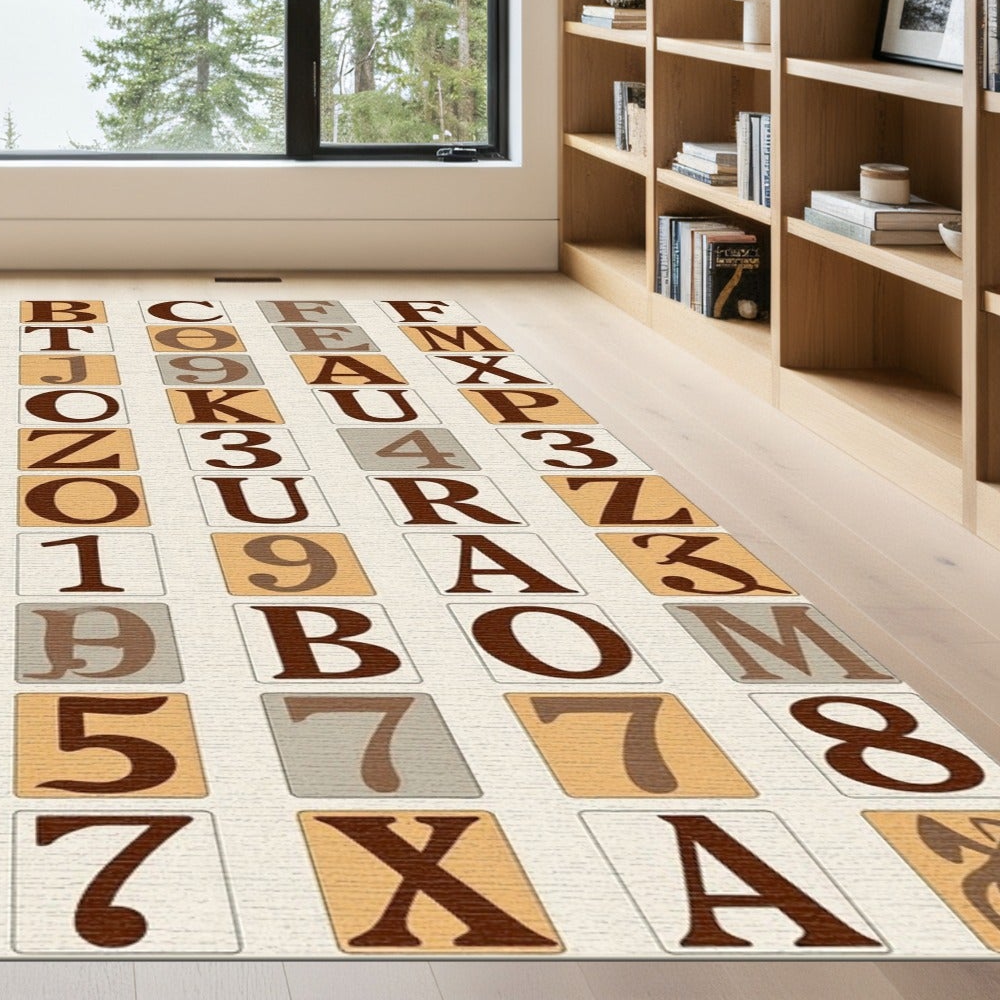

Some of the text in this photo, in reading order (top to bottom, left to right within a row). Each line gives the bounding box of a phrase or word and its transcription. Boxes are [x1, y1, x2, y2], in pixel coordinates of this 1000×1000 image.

[25, 301, 97, 322] B
[148, 301, 223, 322] C
[266, 301, 335, 322] F
[382, 301, 448, 322] F
[25, 326, 94, 351] T
[286, 327, 369, 351] E
[410, 326, 507, 351] M
[41, 356, 86, 384] J
[169, 356, 248, 384] 9
[309, 356, 406, 384] A
[435, 356, 547, 384] X
[25, 390, 119, 423] O
[176, 390, 275, 423] K
[319, 390, 418, 422] U
[469, 390, 559, 423] P
[27, 430, 120, 468] Z
[200, 430, 282, 469] 3
[375, 430, 465, 469] 4
[521, 430, 618, 469] 3
[25, 478, 140, 524] O
[201, 478, 309, 524] U
[376, 478, 522, 524] R
[567, 478, 693, 524] Z
[41, 535, 124, 592] 1
[244, 535, 337, 592] 9
[448, 535, 575, 593] A
[251, 606, 401, 679] B
[472, 606, 632, 679] O
[676, 606, 894, 680] M
[36, 696, 177, 794] 5
[282, 696, 415, 793] 7
[530, 697, 677, 793] 7
[790, 696, 985, 793] 8
[36, 815, 193, 948] 7
[314, 816, 558, 947] X
[657, 815, 882, 947] A
